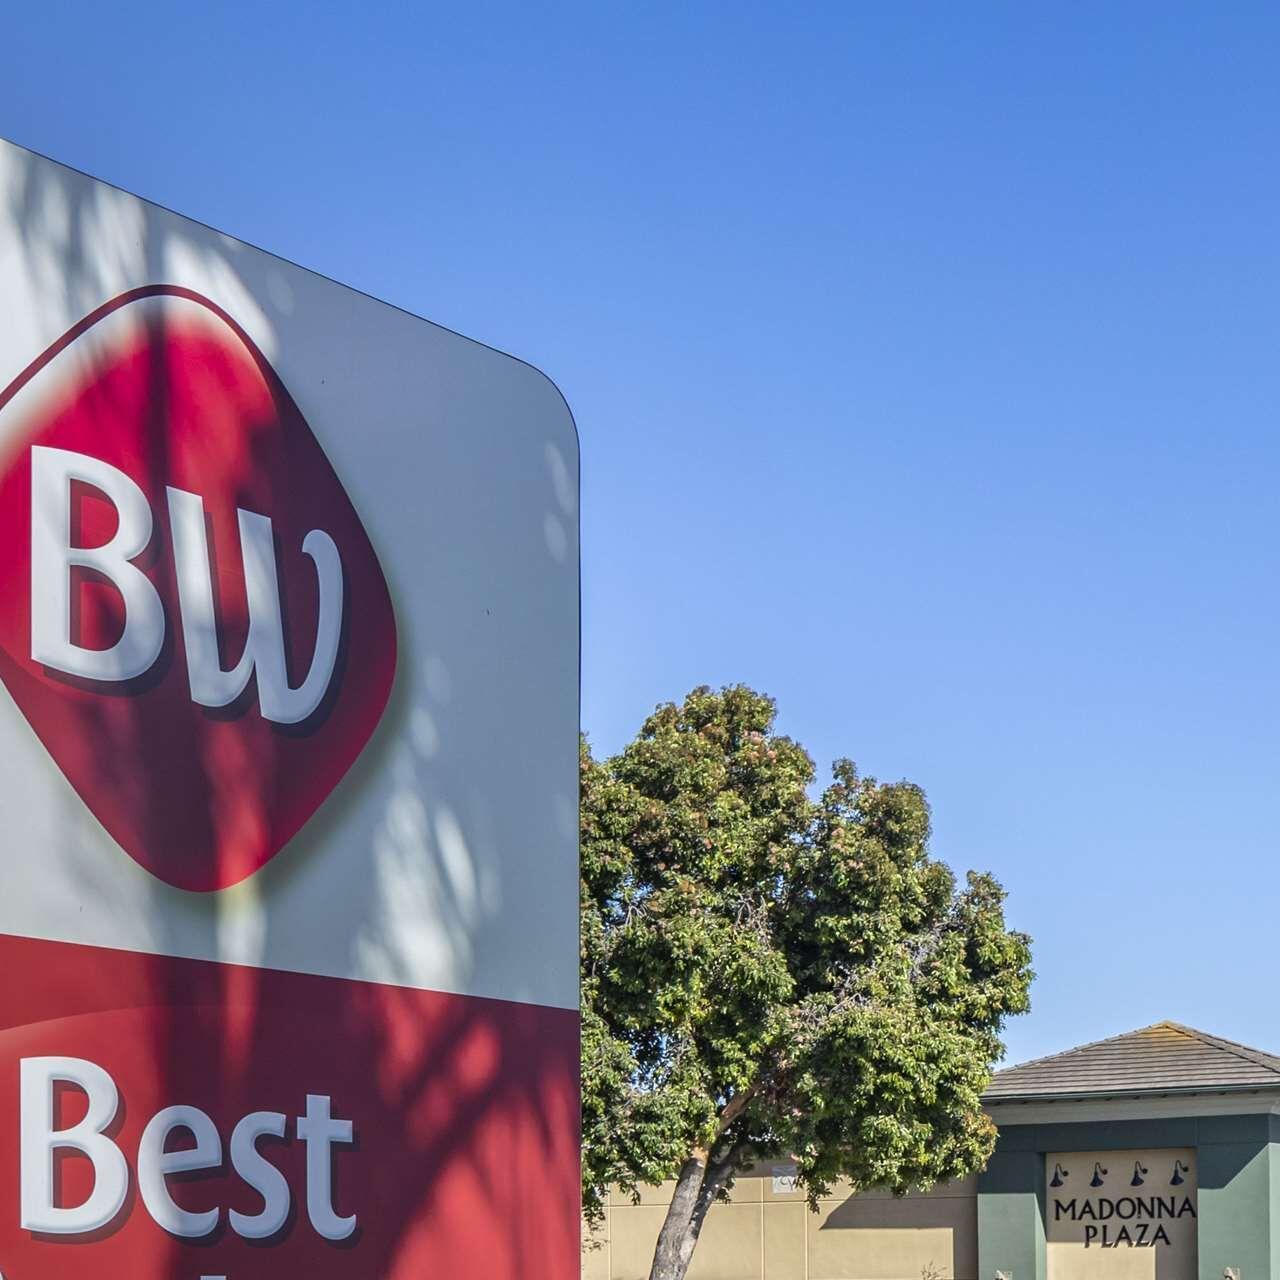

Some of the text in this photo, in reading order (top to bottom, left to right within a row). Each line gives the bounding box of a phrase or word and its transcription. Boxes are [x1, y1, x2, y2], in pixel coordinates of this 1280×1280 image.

[31, 445, 344, 725] BW
[19, 1056, 358, 1240] Best
[1054, 1196, 1197, 1221] MADONNA
[1084, 1223, 1171, 1249] PLAZA
